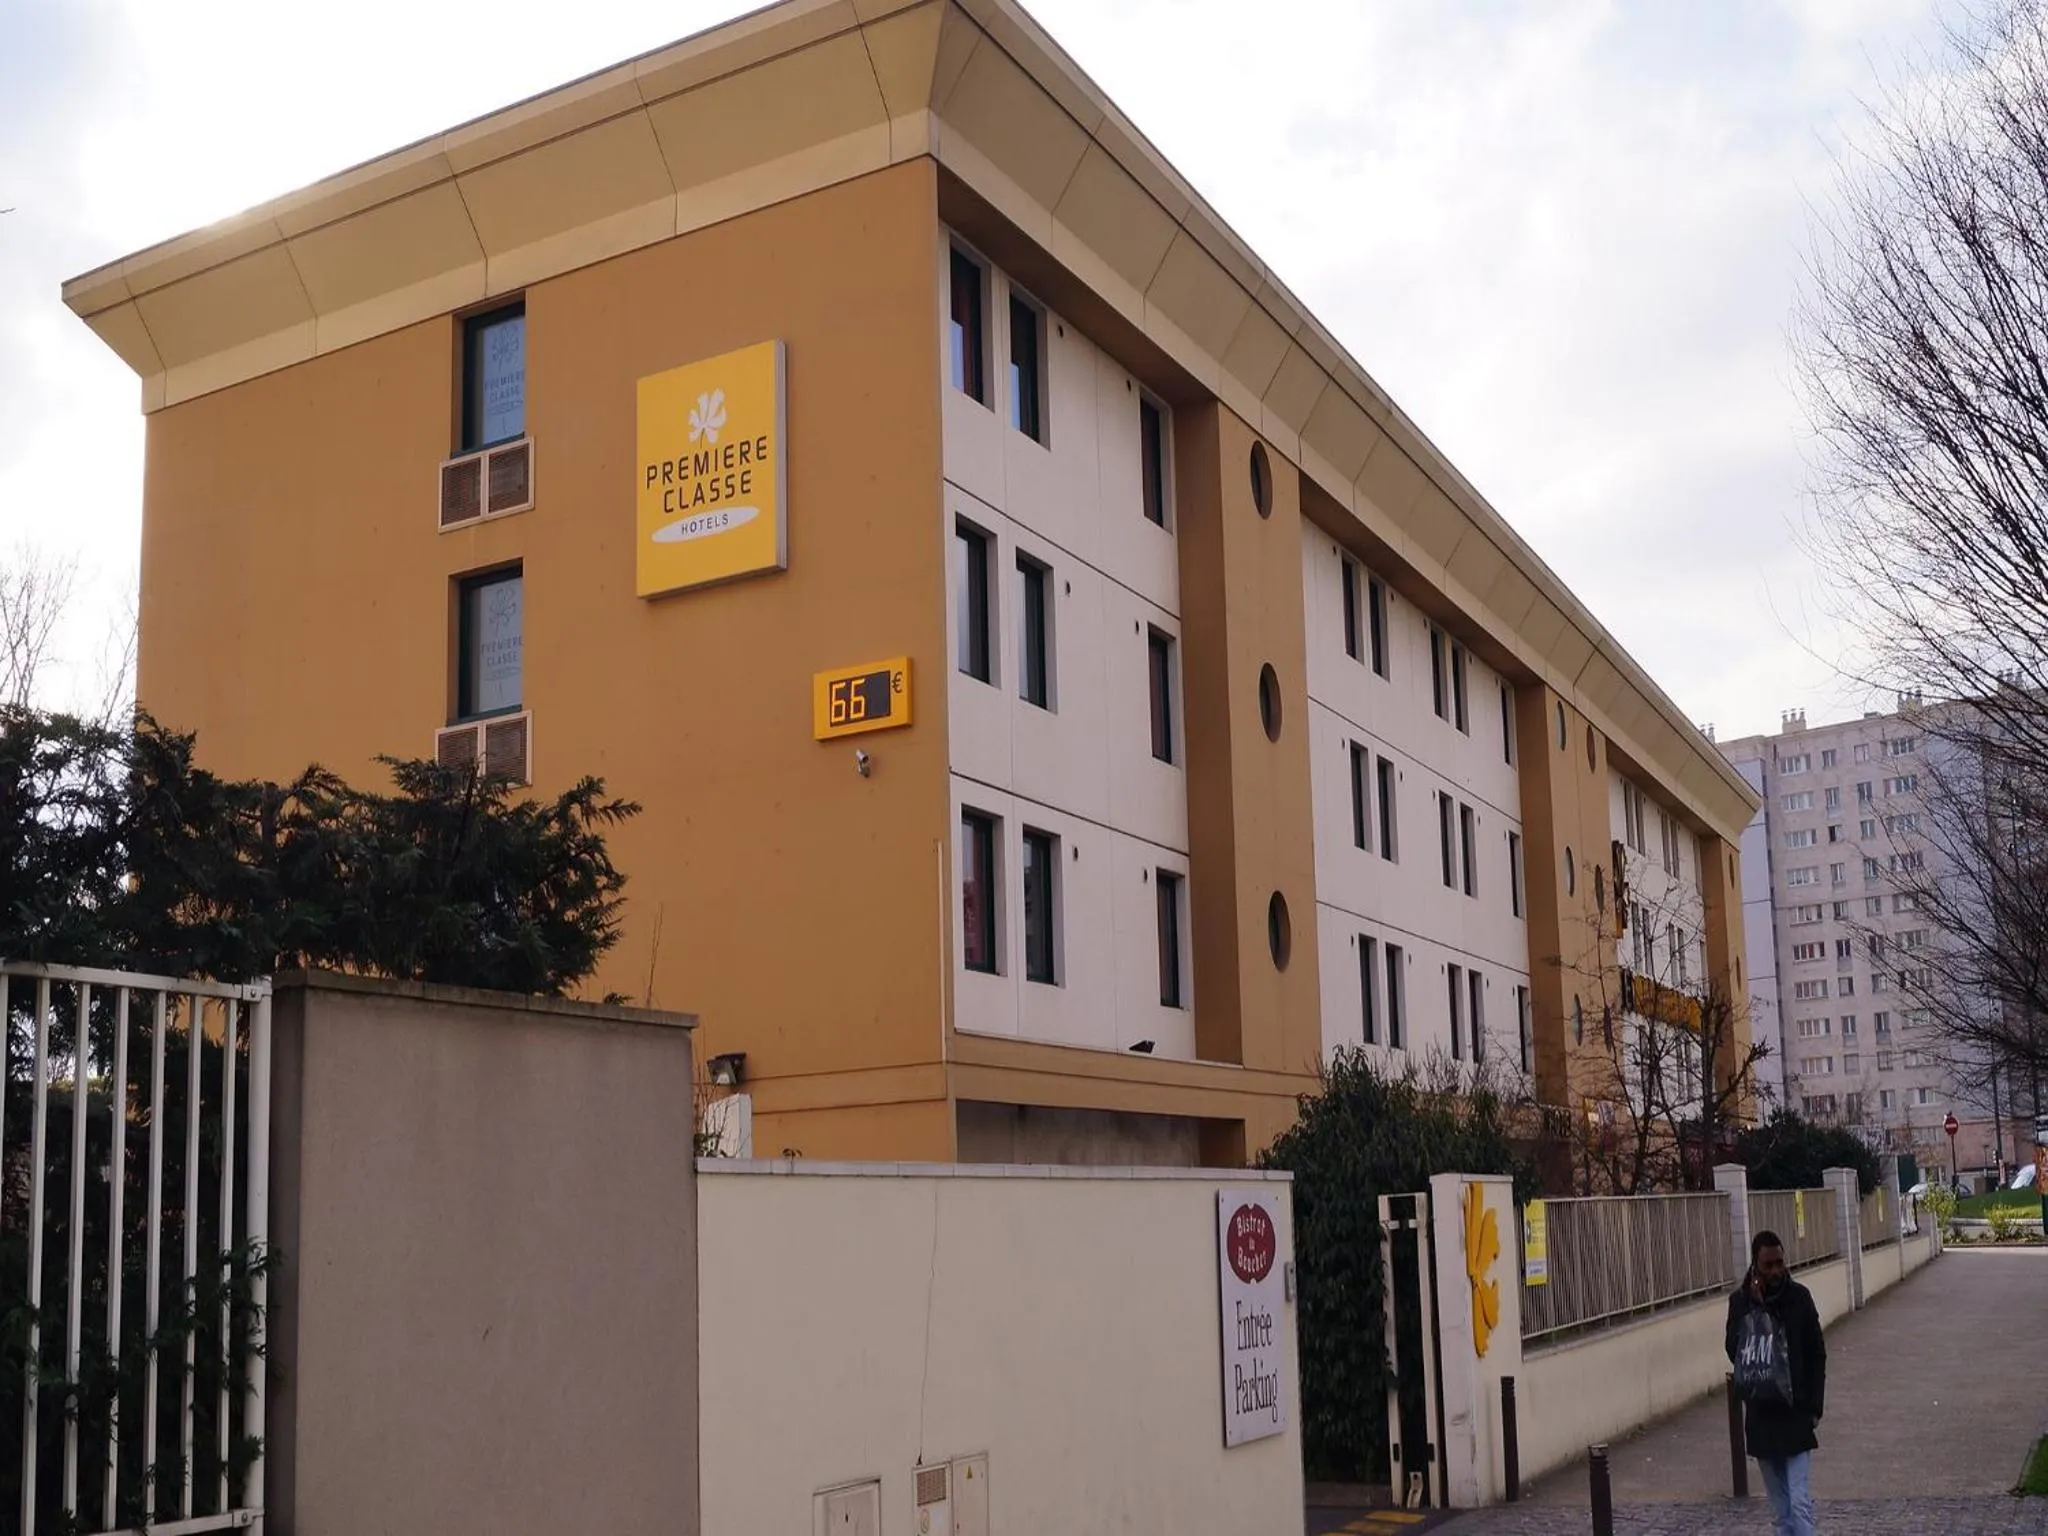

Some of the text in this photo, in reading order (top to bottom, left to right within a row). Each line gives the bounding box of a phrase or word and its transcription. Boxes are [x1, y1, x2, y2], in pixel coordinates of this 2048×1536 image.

[646, 435, 767, 489] PREMIERE
[664, 470, 752, 513] CLASSE
[681, 514, 729, 535] HOTELS
[831, 678, 865, 723] 66
[1236, 1300, 1272, 1351] Entrée
[1235, 1357, 1278, 1423] Parking
